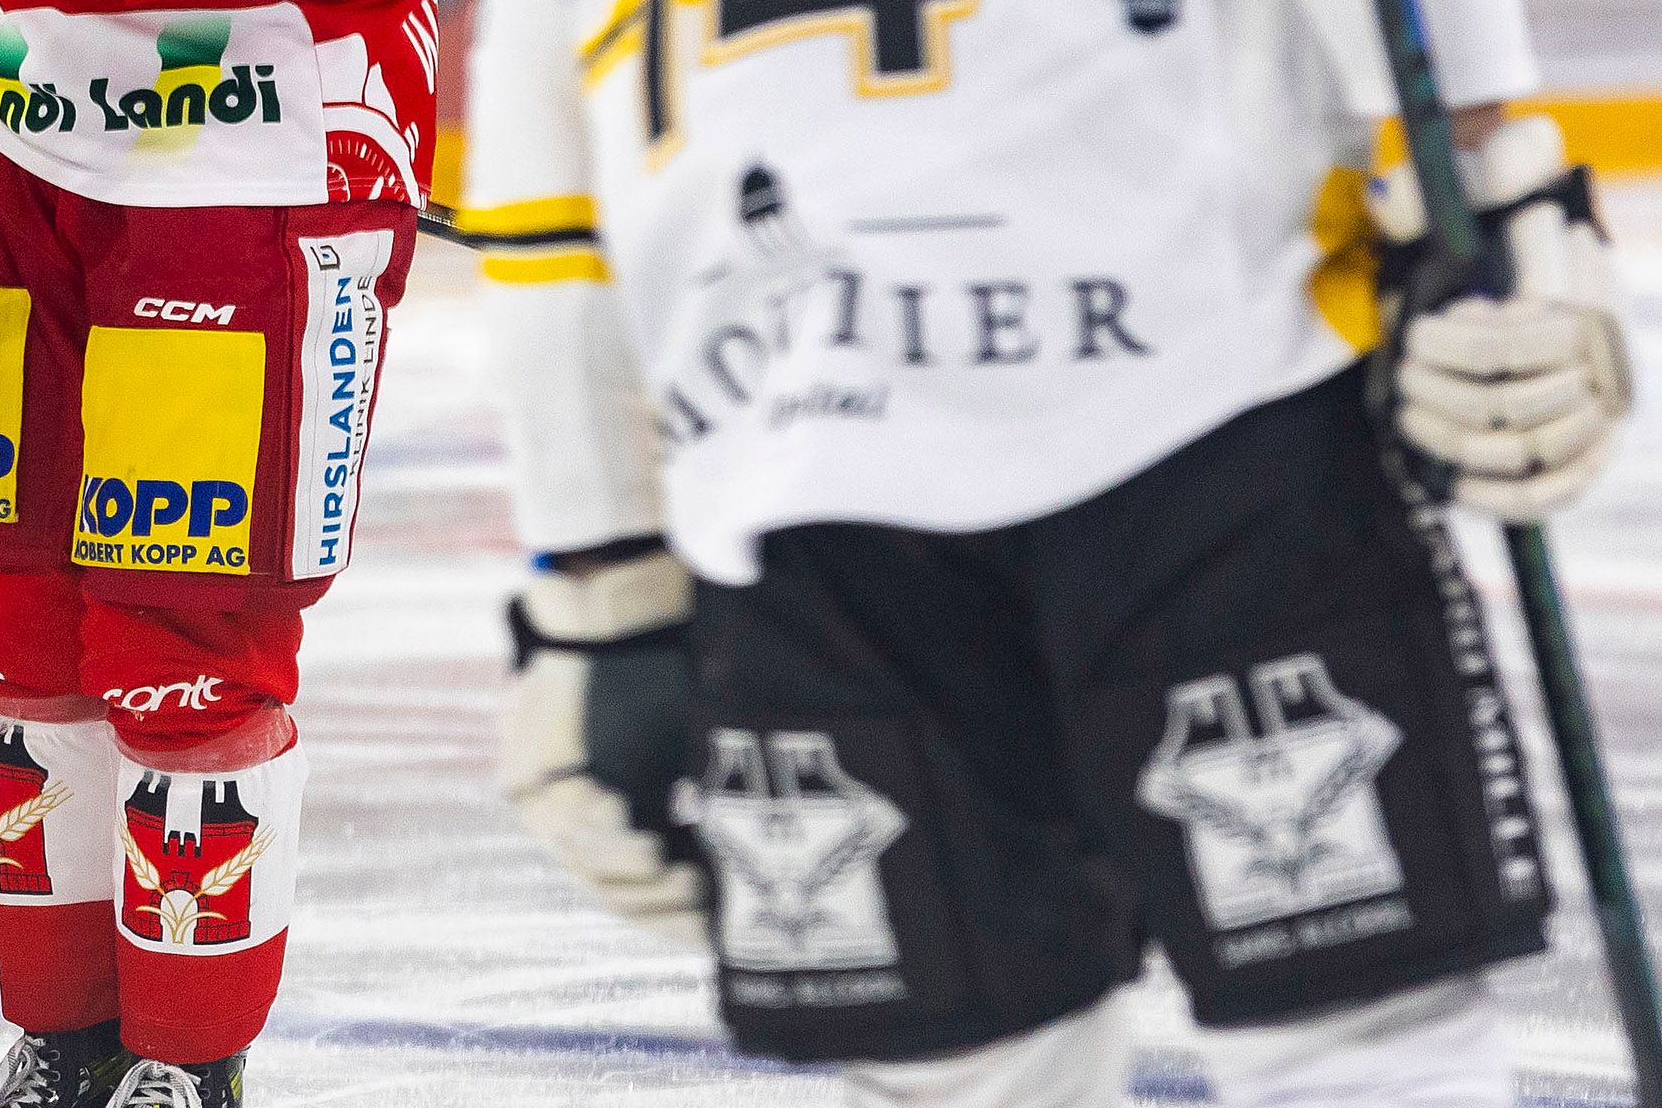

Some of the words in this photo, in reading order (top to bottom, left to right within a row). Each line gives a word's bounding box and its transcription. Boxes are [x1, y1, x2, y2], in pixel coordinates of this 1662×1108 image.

[89, 63, 282, 133] Landi
[134, 296, 236, 327] CCM
[357, 274, 378, 366] LINDE
[319, 274, 357, 567] HIRSLANDEN
[79, 474, 250, 541] KOPP
[130, 543, 201, 567] KOPP
[206, 543, 248, 570] AG
